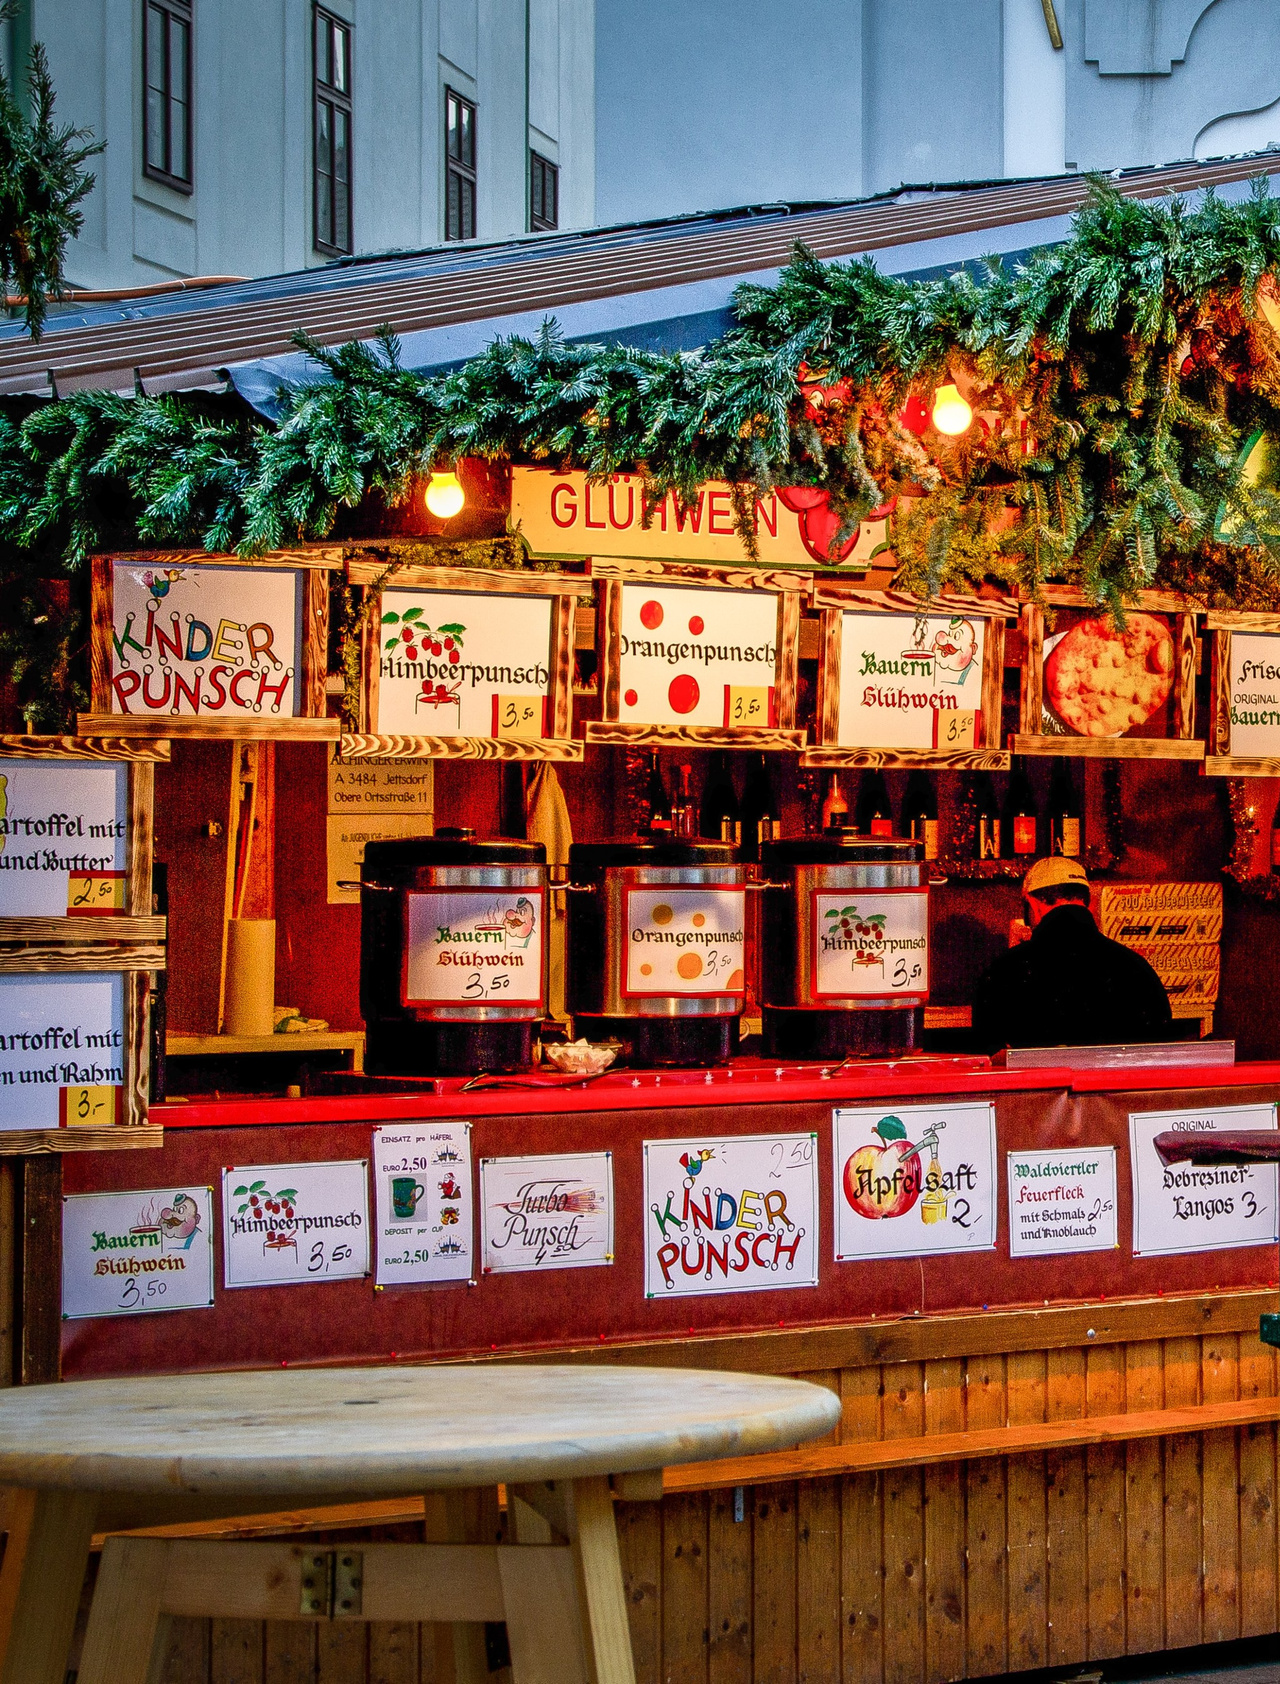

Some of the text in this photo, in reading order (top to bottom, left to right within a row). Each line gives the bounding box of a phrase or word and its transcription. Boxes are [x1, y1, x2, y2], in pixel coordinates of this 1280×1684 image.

[551, 475, 778, 538] GLÜHWEN
[113, 599, 283, 670] KINDER
[379, 655, 550, 689] Himbeerpunsch
[858, 650, 934, 677] Bauern
[113, 664, 295, 716] PUNSCH
[860, 684, 960, 713] Glühwein
[1233, 693, 1279, 706] ORIGINAL
[501, 702, 535, 728] 3,50
[734, 697, 761, 720] 3,50
[330, 756, 428, 766] AICHINGER ERWIN
[334, 773, 428, 786] A 3484 Jettsdorf
[334, 791, 427, 803] Obere Ortsstraße 11
[88, 819, 127, 838] mit
[0, 849, 114, 872] und Butter
[73, 877, 113, 906] 2,50
[434, 926, 504, 944] Bauern
[632, 928, 743, 946] Orangenpunsch
[821, 935, 926, 954] Himbeerpunsch
[436, 951, 524, 970] Glühwein
[703, 951, 732, 977] 3,50
[892, 959, 922, 987] 3,50
[461, 973, 510, 999] 3,50
[85, 1029, 123, 1048] mit
[17, 1062, 60, 1084] und
[59, 1062, 124, 1086] Rahm
[430, 1133, 453, 1141] HÄFERL
[1171, 1120, 1217, 1132] ORIGINAL
[401, 1157, 427, 1173] 2,50
[1014, 1161, 1099, 1181] Waldviertler
[853, 1163, 978, 1204] Apfelsaft
[1016, 1184, 1085, 1204] Feuerfleck
[505, 1180, 583, 1214] Turbo
[1173, 1196, 1234, 1220] Langos
[652, 1177, 795, 1242] KINDER
[1020, 1212, 1040, 1223] mit
[230, 1209, 362, 1238] Himbeerpunsch
[491, 1213, 593, 1250] Punsch
[1021, 1223, 1096, 1240] und Knoblauch
[90, 1231, 160, 1252] Bauern
[93, 1254, 186, 1277] Glühwein
[307, 1241, 352, 1272] 3,50
[403, 1249, 429, 1265] 2,50
[657, 1228, 806, 1289] PUNSCH
[117, 1278, 167, 1309] 3,50
